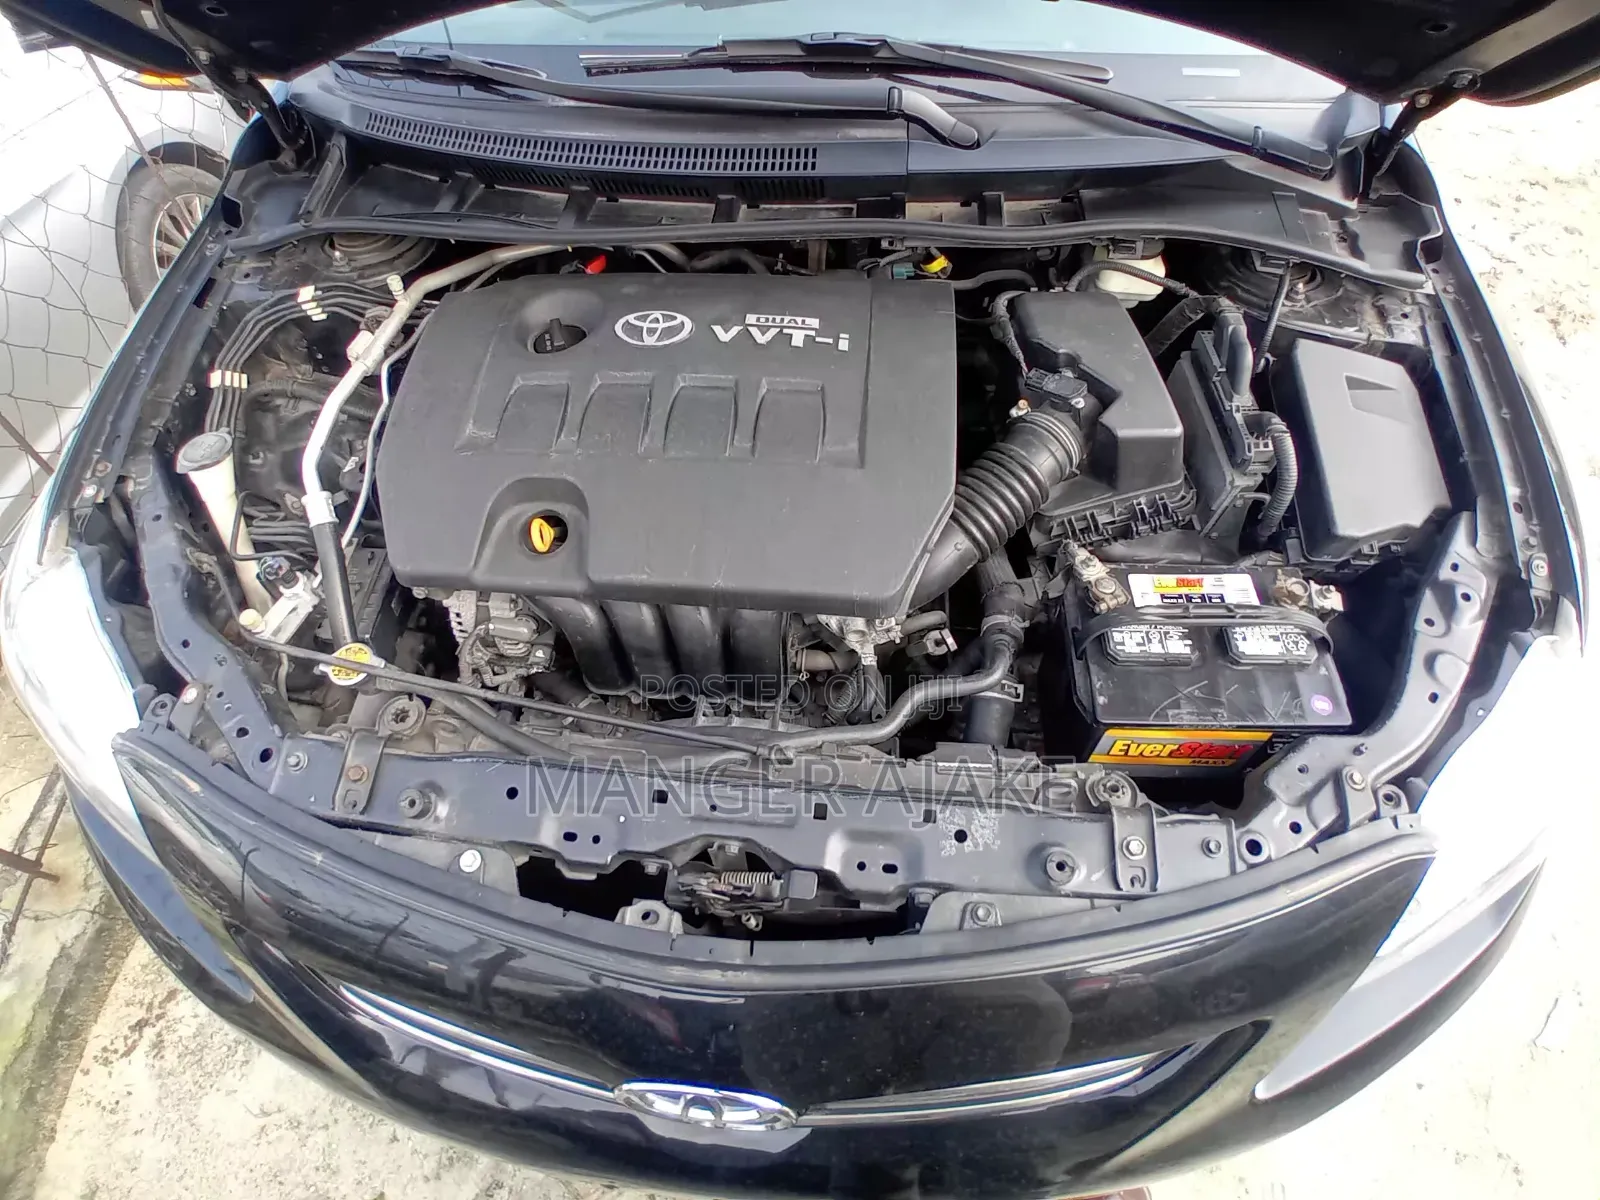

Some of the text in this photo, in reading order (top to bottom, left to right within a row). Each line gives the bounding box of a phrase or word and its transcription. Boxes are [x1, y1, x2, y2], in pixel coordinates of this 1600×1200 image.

[755, 315, 813, 326] DUAL
[710, 324, 850, 352] VVT-i
[1108, 740, 1254, 759] EverStart
